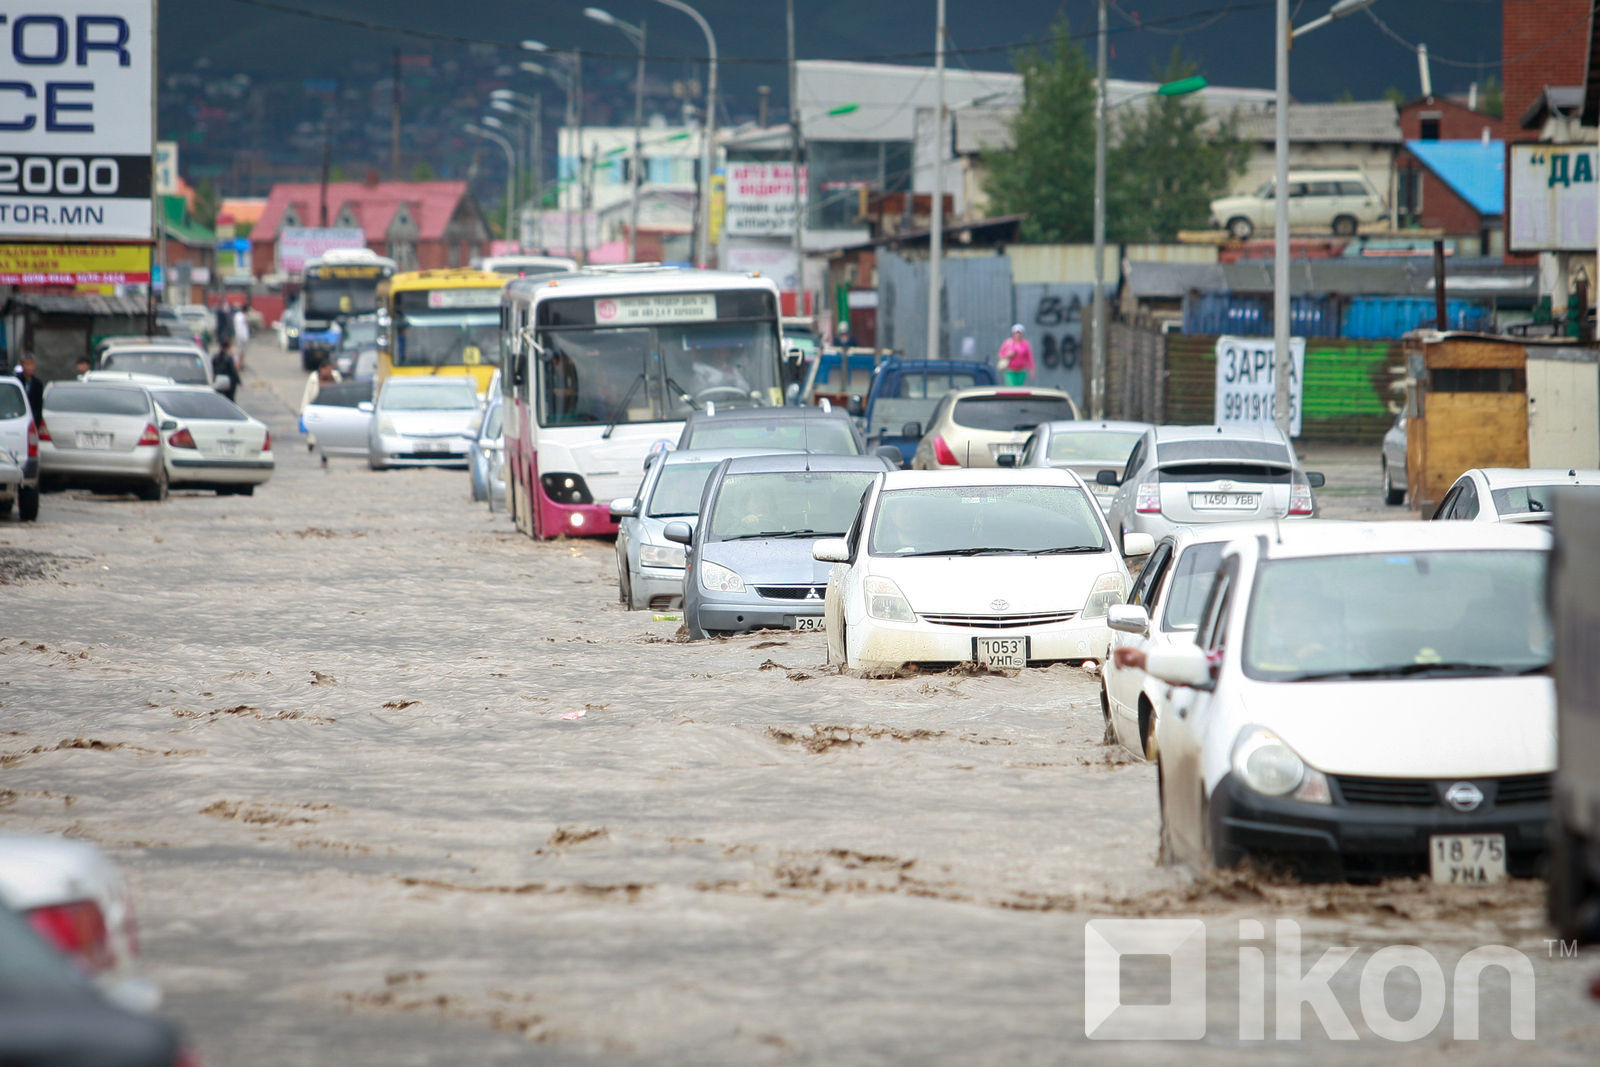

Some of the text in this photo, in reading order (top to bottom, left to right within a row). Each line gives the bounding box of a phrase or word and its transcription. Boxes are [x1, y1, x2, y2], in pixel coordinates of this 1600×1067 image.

[0, 14, 131, 67] OR
[0, 81, 95, 133] CE
[0, 156, 120, 195] 2000
[1530, 152, 1599, 189] “ДА
[1203, 494, 1228, 505] 1450
[985, 640, 1018, 654] 1053
[989, 655, 1012, 666] УНП
